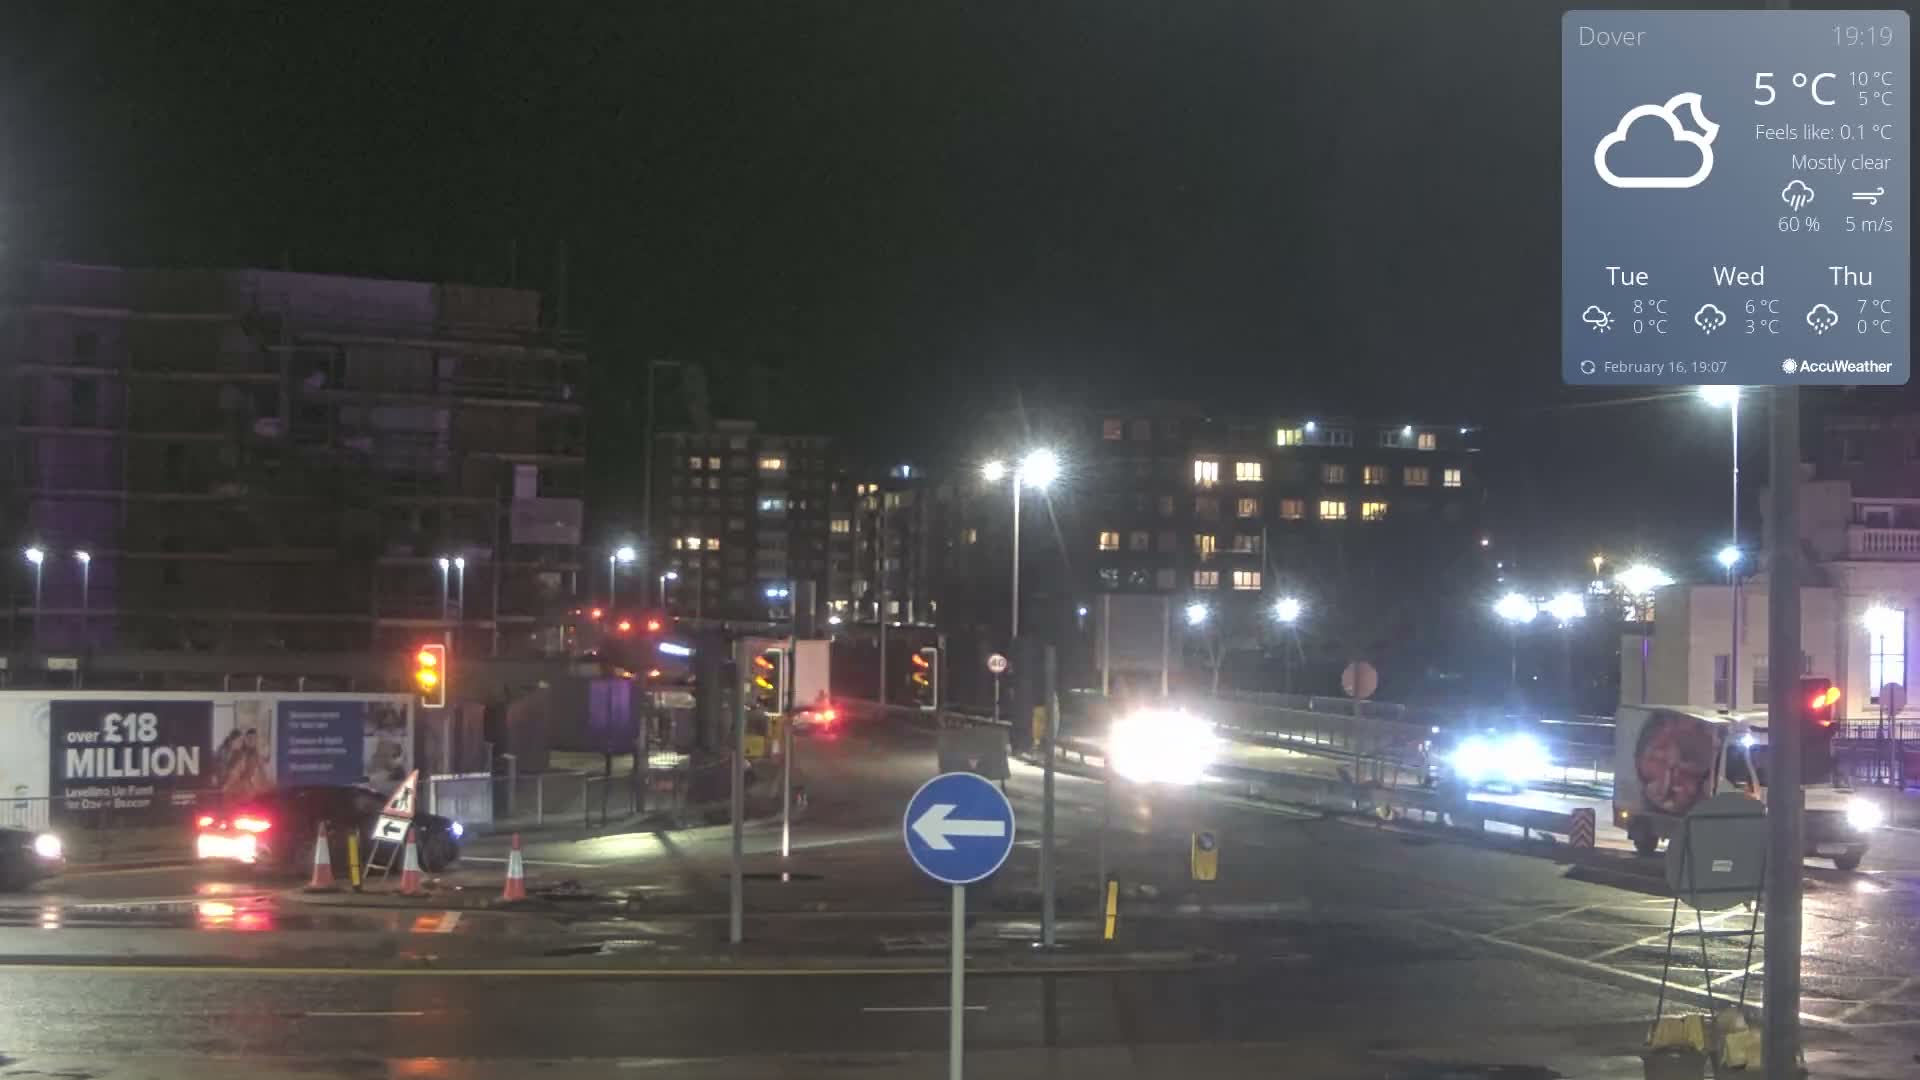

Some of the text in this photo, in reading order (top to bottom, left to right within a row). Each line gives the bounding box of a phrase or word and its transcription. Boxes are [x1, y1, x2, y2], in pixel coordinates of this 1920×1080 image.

[67, 712, 158, 743] over £18
[66, 746, 200, 779] MILLION
